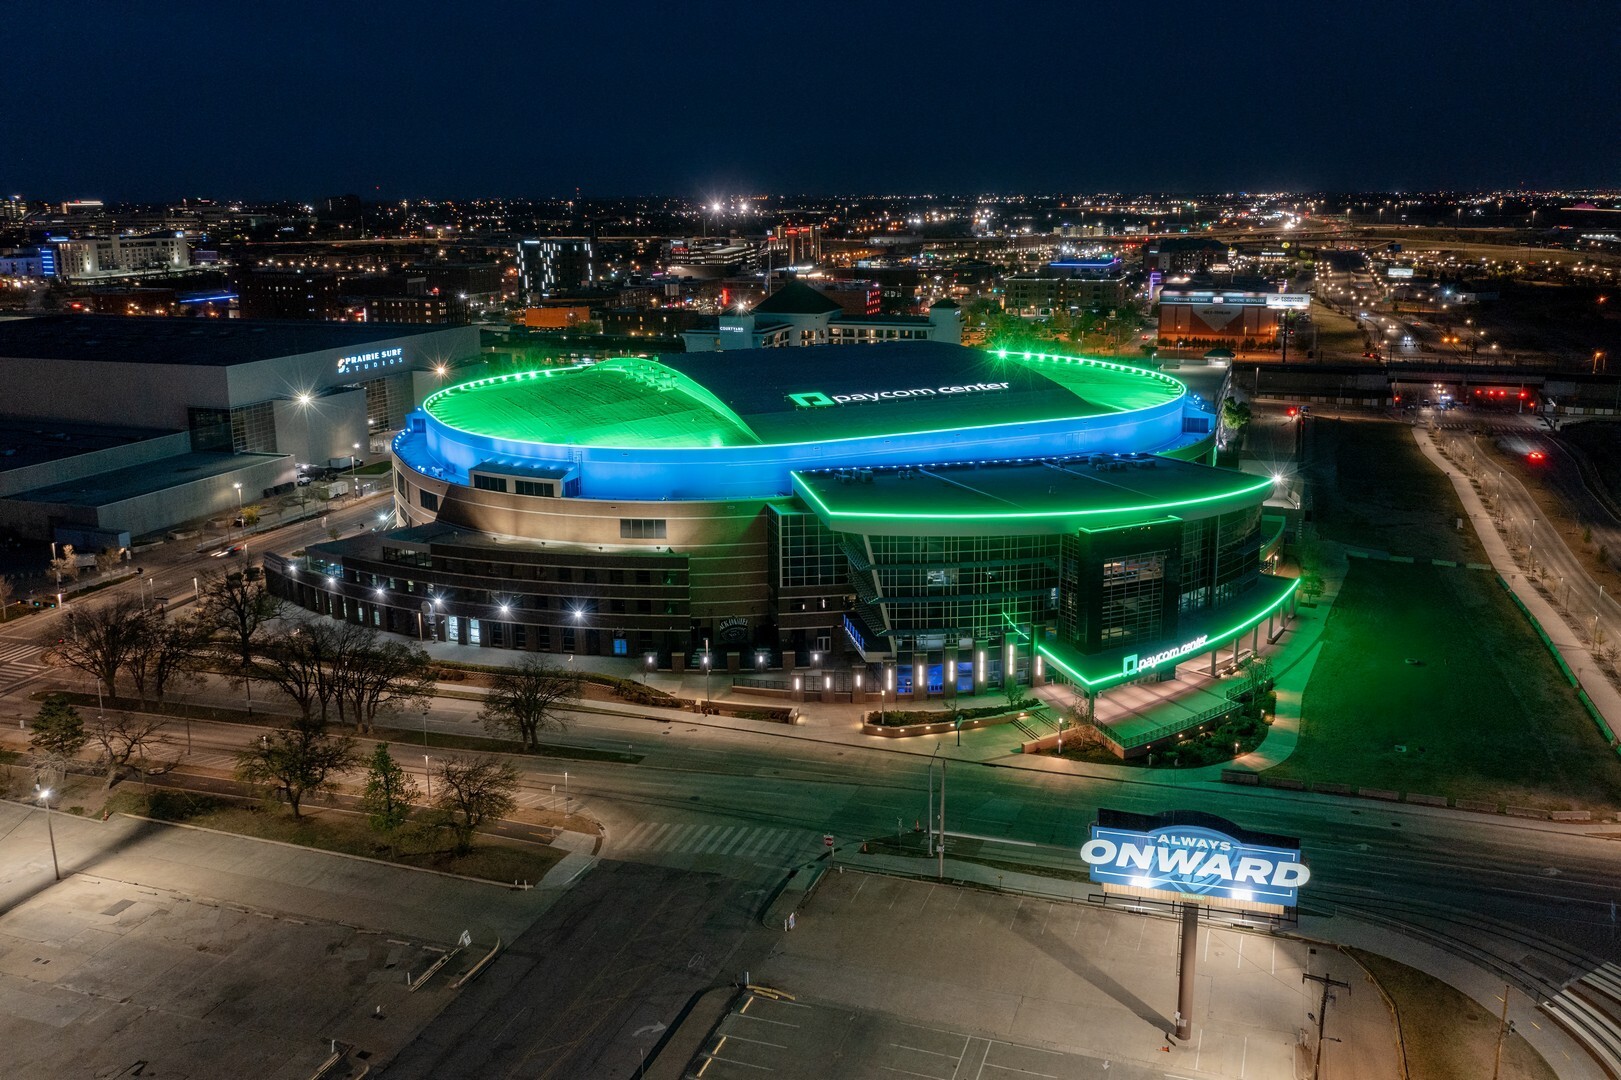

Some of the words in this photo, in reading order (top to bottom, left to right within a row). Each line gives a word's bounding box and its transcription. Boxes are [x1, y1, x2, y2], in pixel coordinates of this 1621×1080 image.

[345, 352, 380, 364] PRAIRIE
[381, 348, 402, 358] SURF
[346, 358, 402, 372] STUDIOS
[832, 388, 936, 403] paycom
[938, 381, 1009, 394] center
[1138, 648, 1179, 672] paycom
[1181, 635, 1208, 653] center
[1157, 834, 1231, 851] ALWAYS
[1080, 839, 1310, 887] ONWARD
